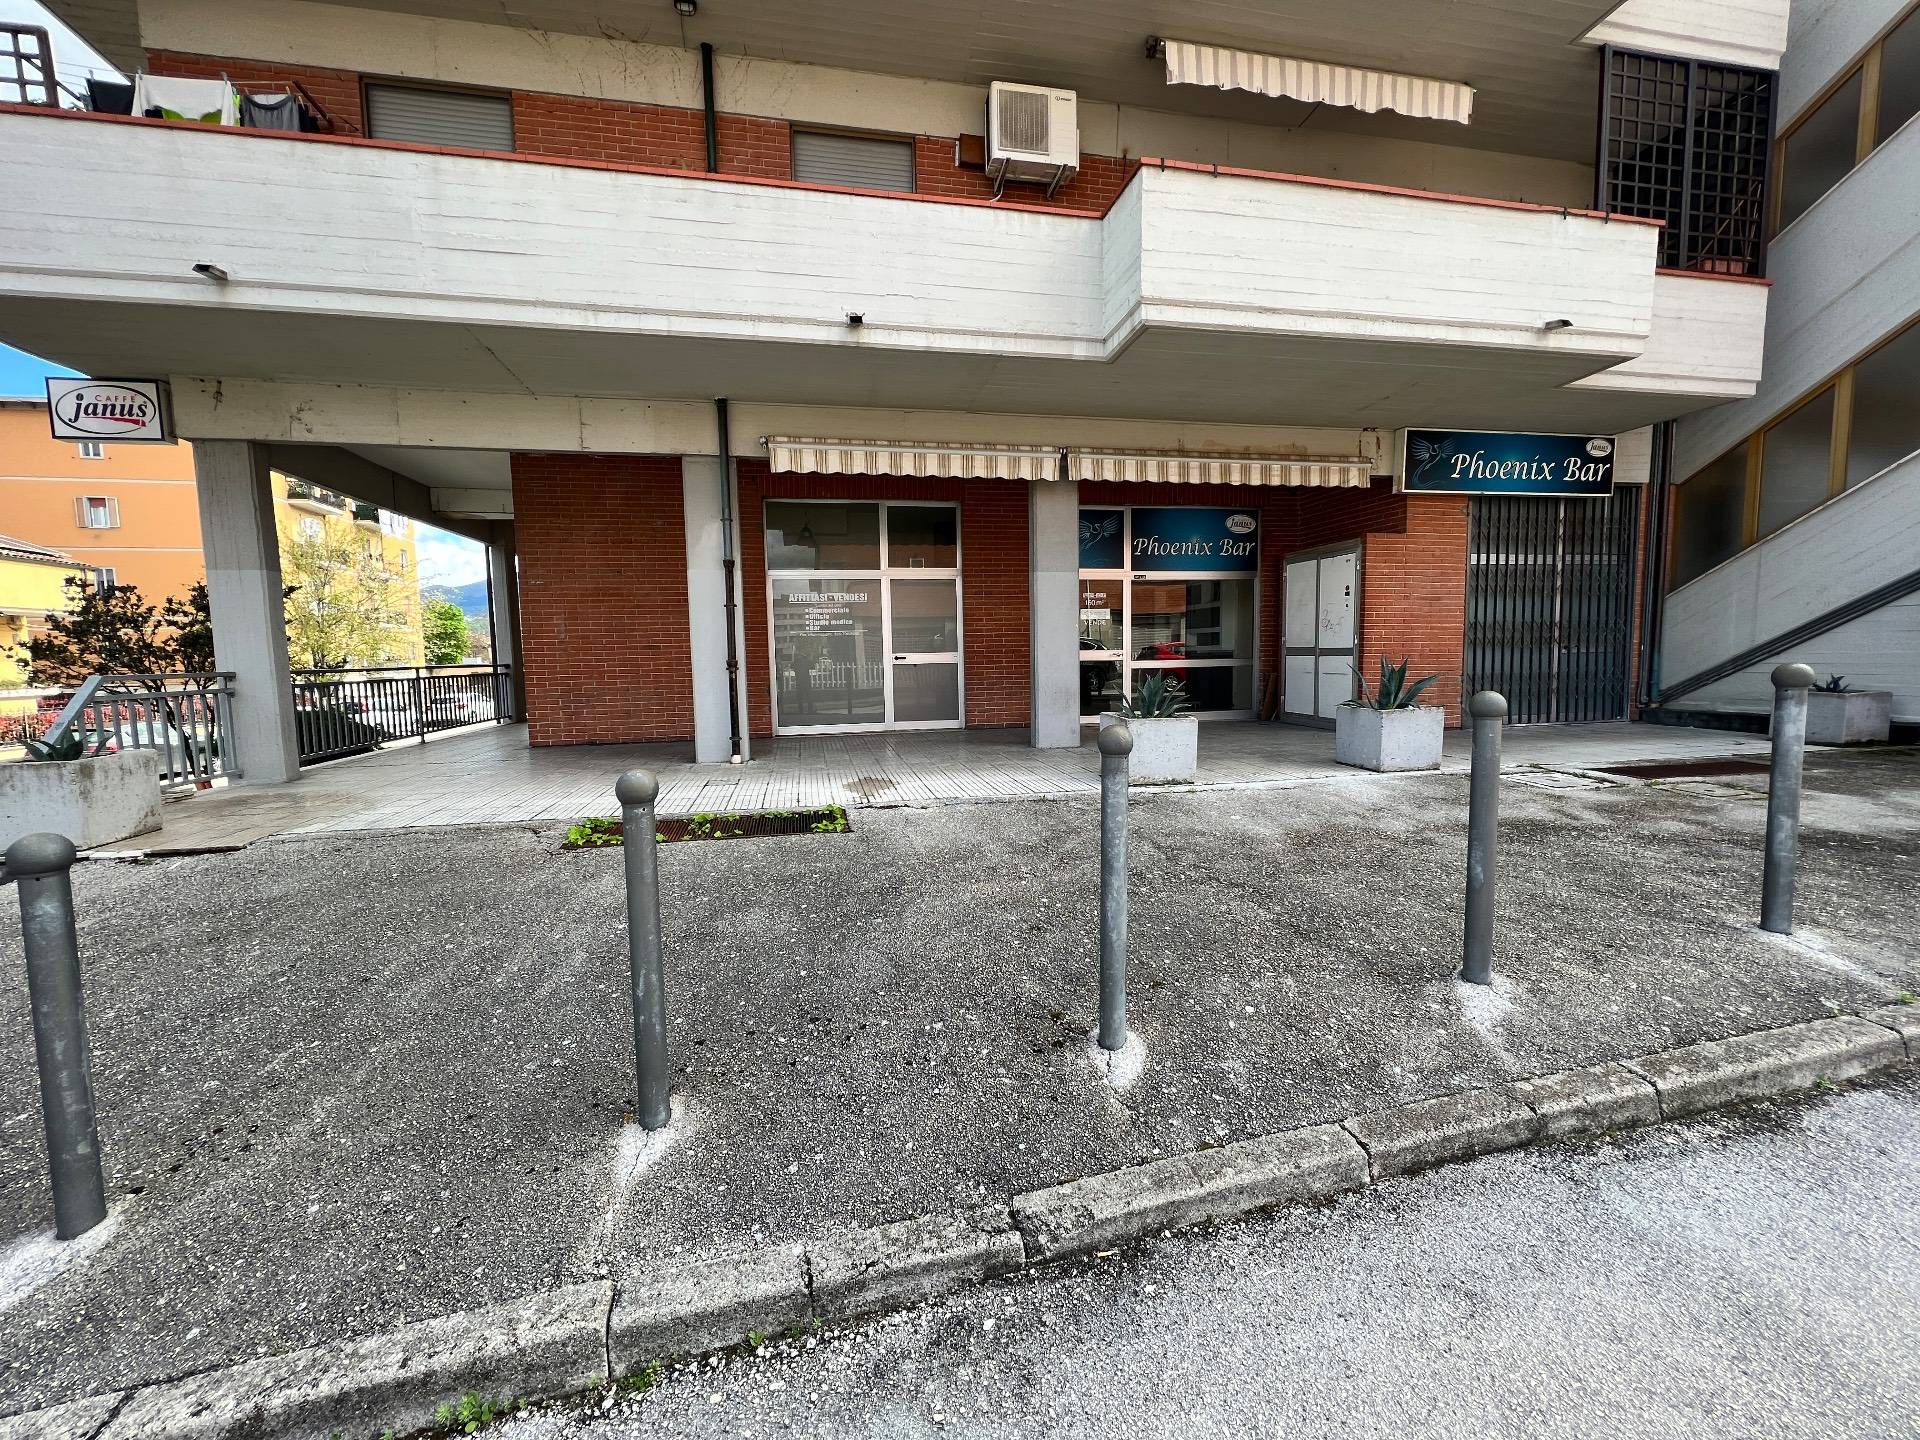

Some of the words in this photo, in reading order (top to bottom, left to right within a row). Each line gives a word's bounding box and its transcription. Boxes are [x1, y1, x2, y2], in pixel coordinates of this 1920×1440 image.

[68, 393, 148, 423] janus
[1450, 450, 1556, 481] Phoenix
[1563, 457, 1610, 482] Bar
[1133, 535, 1213, 556] Phoenix
[1219, 538, 1256, 556] Bar
[789, 593, 828, 602] AFFITTASI
[833, 593, 868, 602] VENDESI
